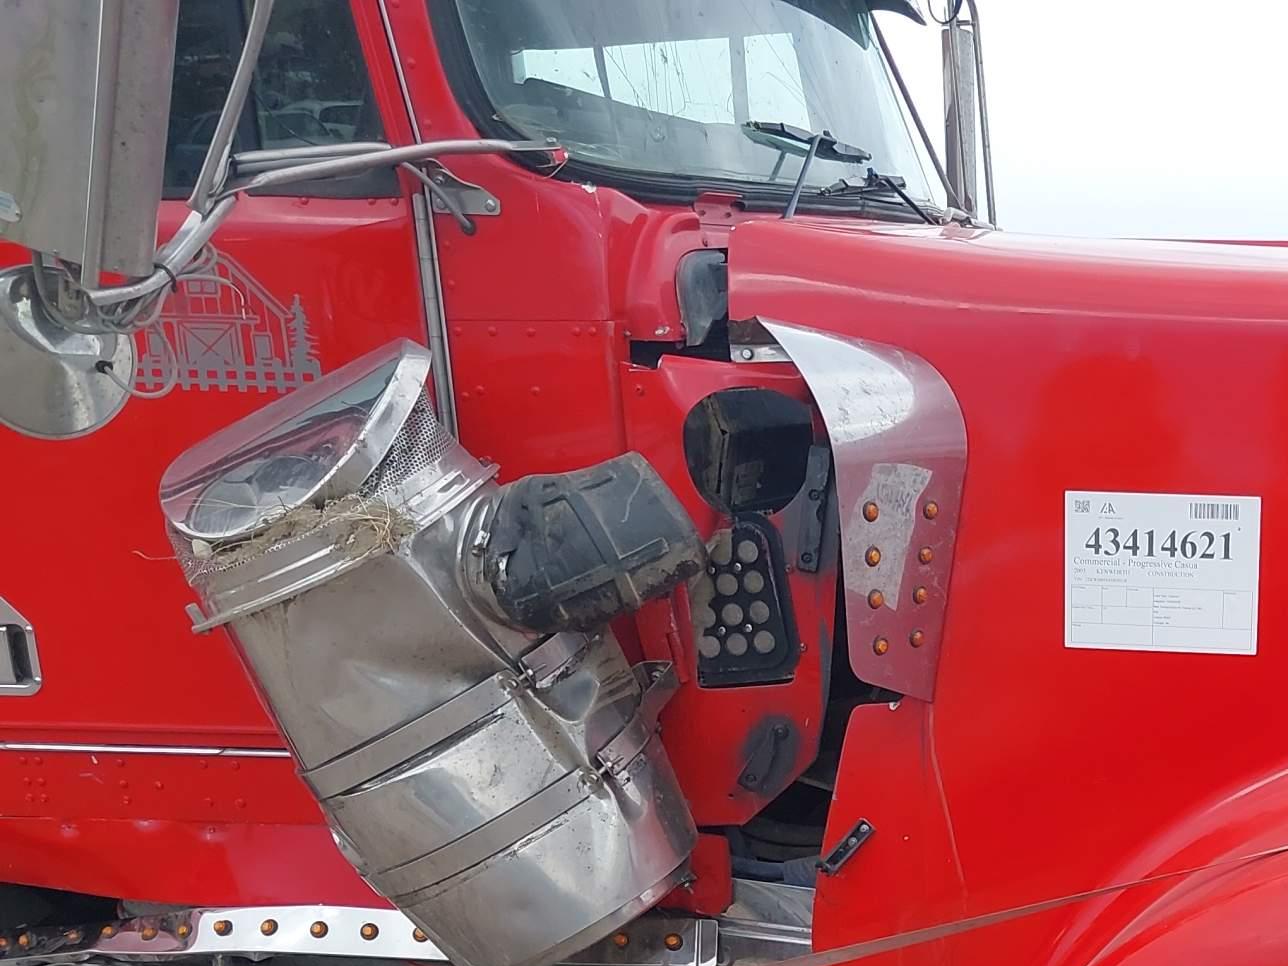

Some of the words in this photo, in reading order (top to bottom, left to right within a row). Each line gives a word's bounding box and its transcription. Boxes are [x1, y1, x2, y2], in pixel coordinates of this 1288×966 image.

[1084, 527, 1233, 561] 43414621
[1073, 556, 1120, 567] Commercial
[1128, 558, 1172, 569] Progressive
